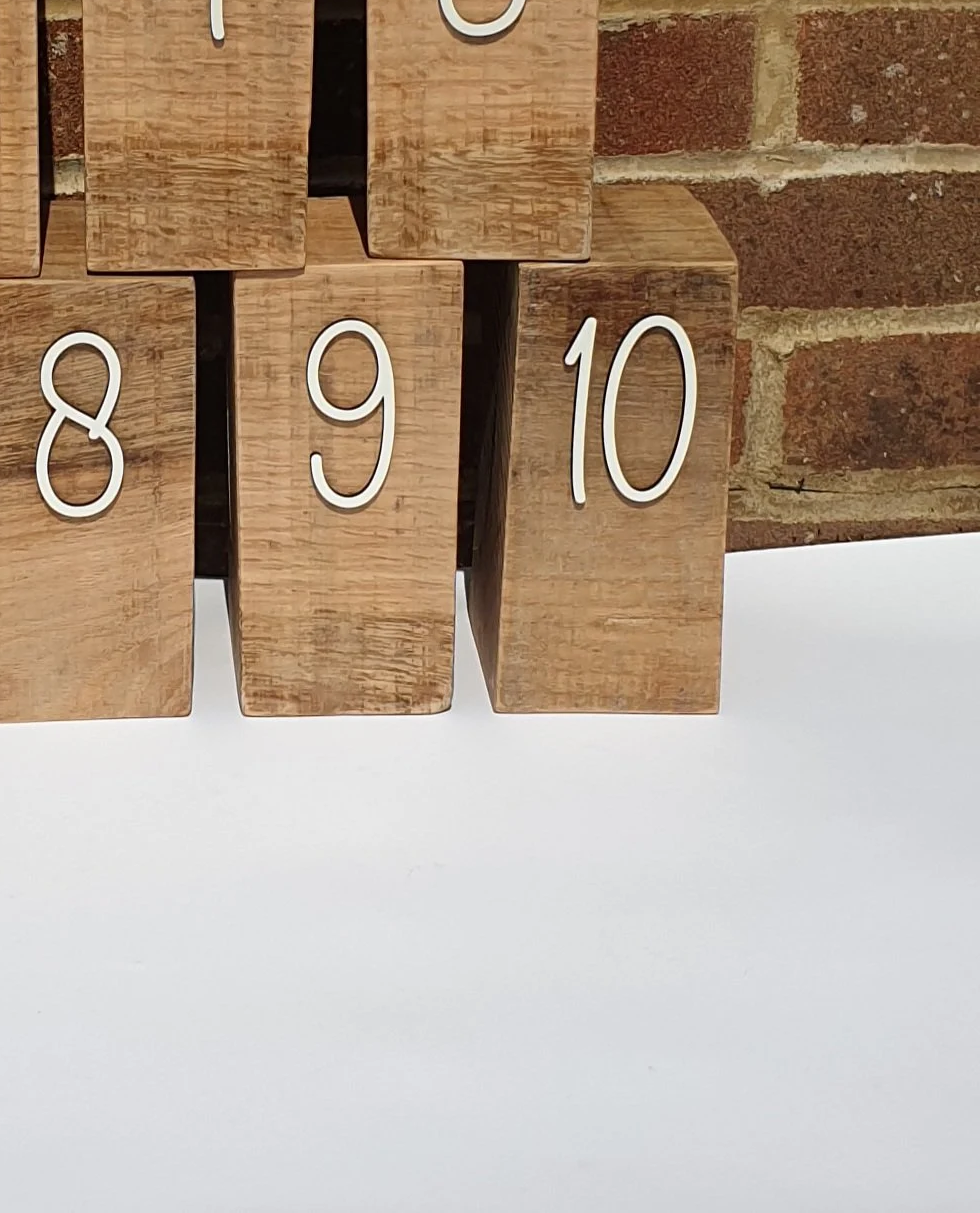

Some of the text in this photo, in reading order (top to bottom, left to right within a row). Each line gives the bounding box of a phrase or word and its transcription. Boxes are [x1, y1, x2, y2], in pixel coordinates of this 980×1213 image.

[37, 333, 124, 518] 8
[308, 320, 396, 509] 9
[565, 316, 697, 504] 10
